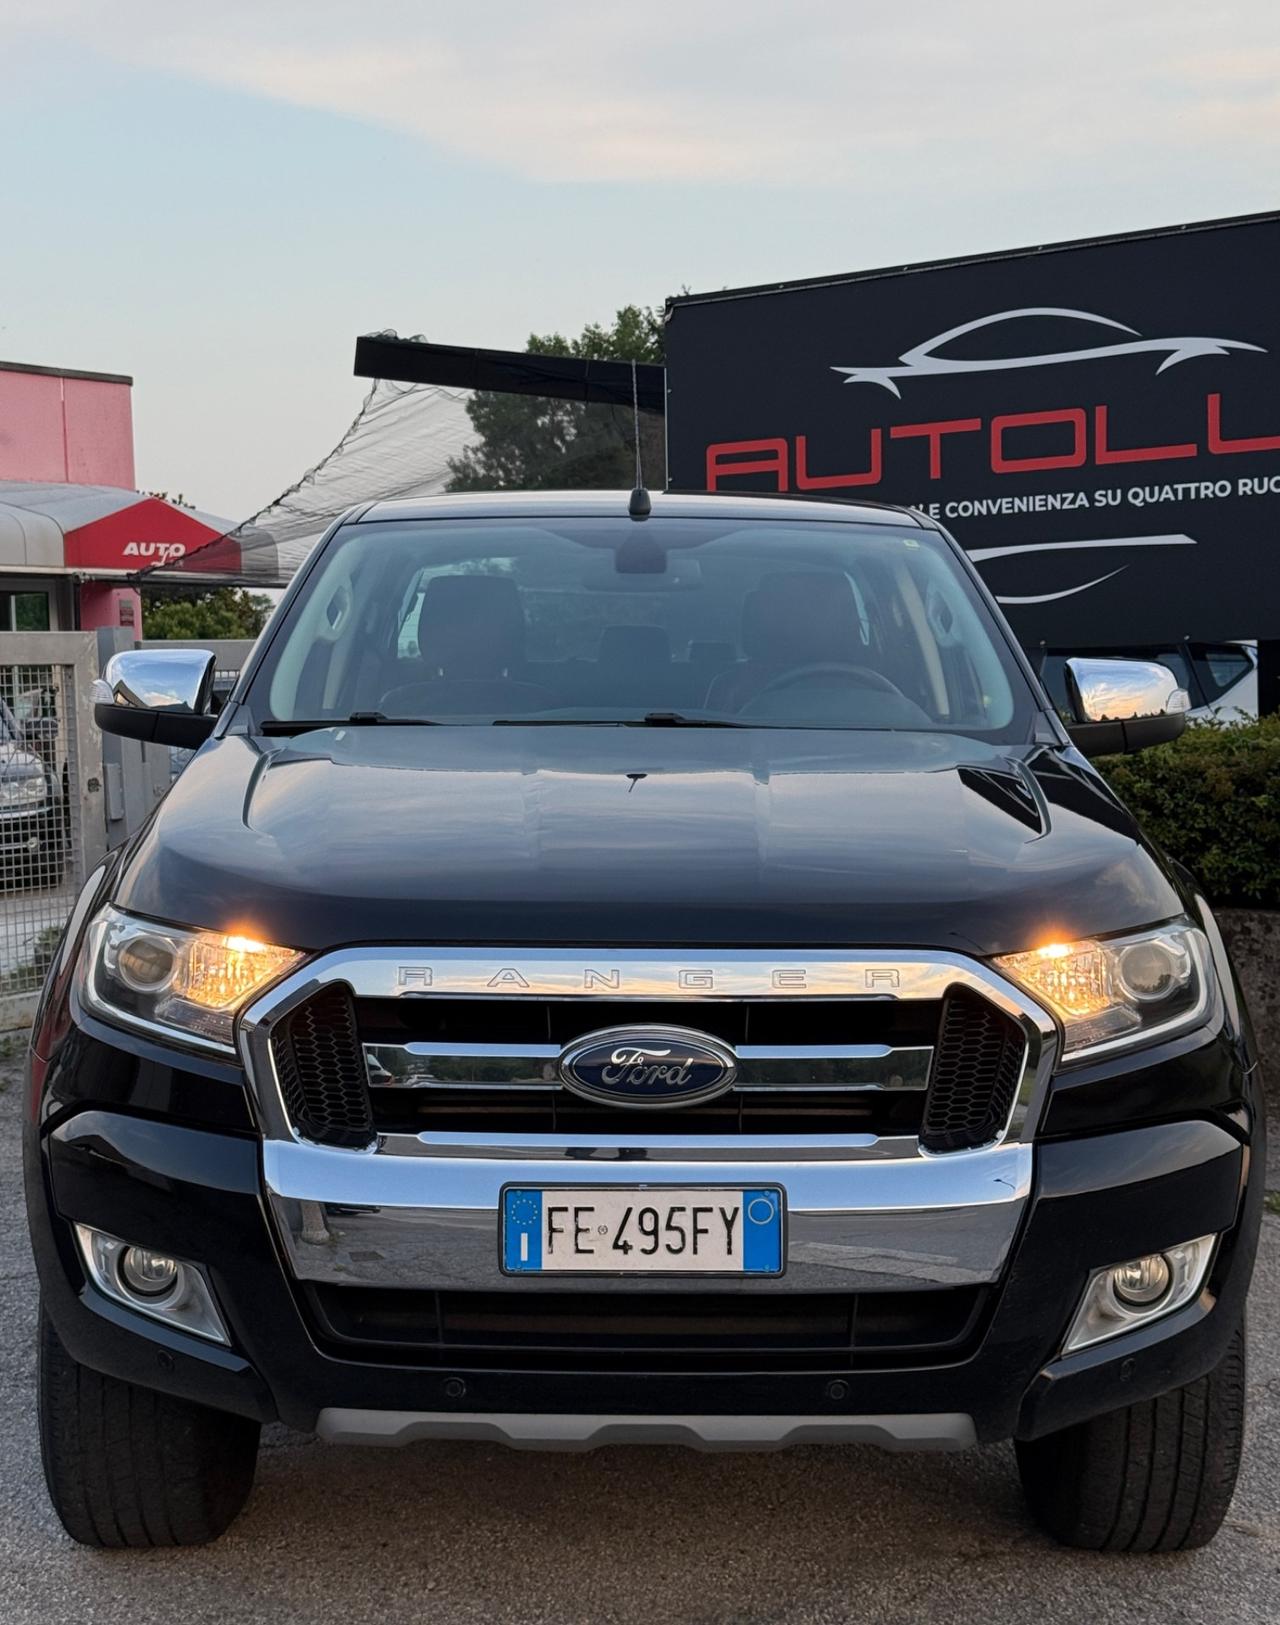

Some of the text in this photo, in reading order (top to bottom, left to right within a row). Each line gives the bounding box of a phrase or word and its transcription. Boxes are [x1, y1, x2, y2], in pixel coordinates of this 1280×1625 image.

[929, 503, 941, 519] E
[945, 492, 1090, 518] CONVENIENZA
[1094, 489, 1122, 507] SU
[1127, 480, 1232, 507] QUATTRO
[122, 542, 186, 557] AUTO
[398, 966, 901, 990] RANGER
[601, 1047, 694, 1085] Ford
